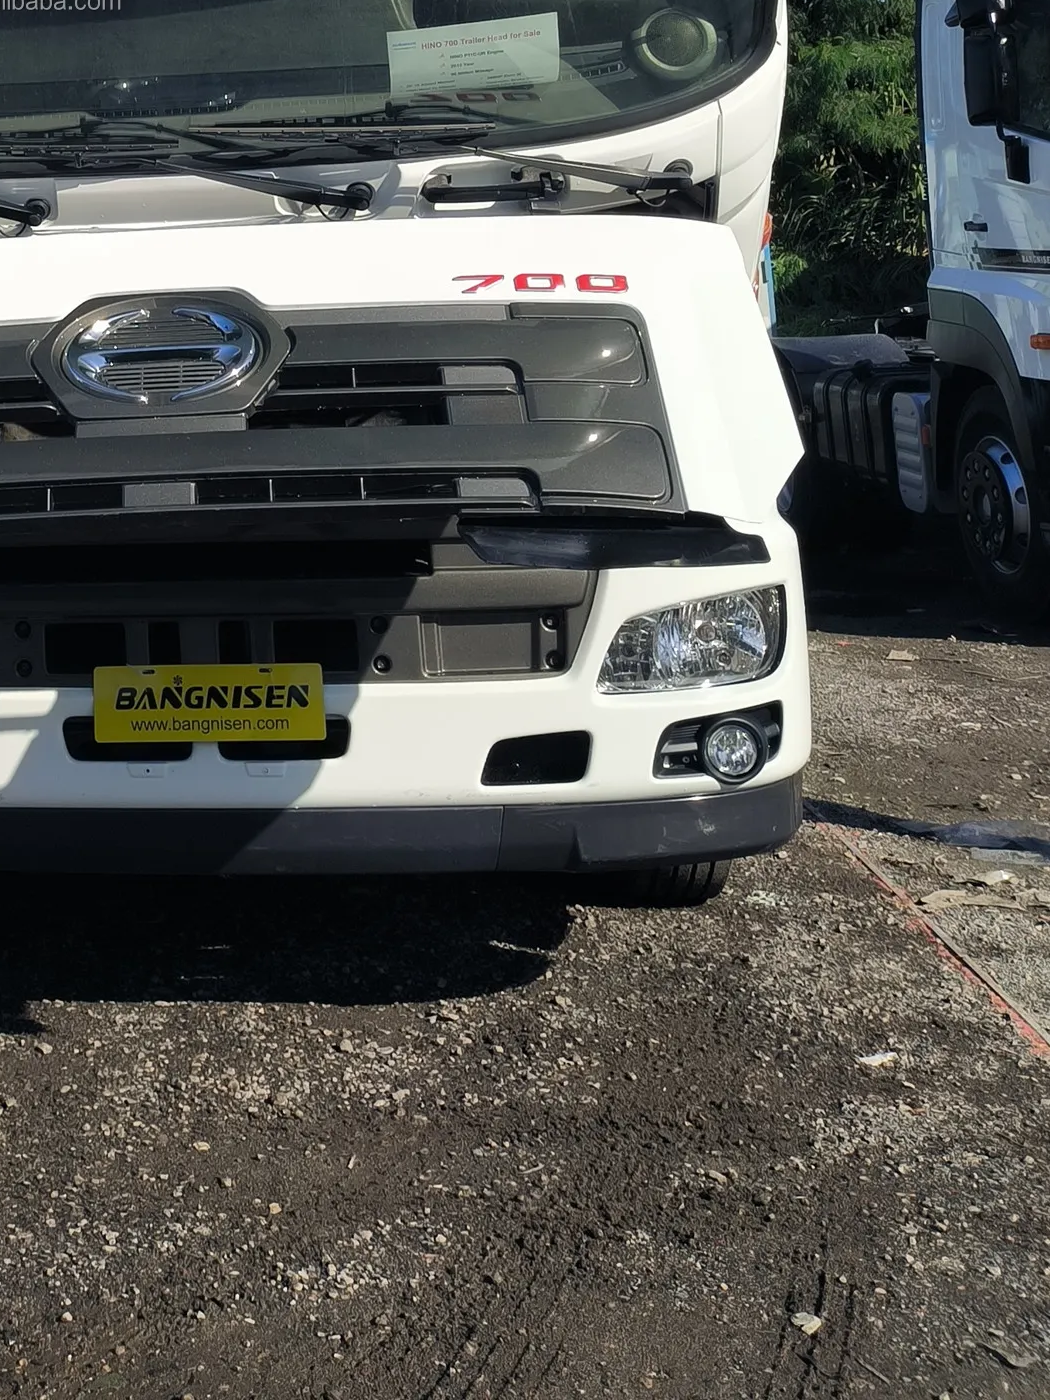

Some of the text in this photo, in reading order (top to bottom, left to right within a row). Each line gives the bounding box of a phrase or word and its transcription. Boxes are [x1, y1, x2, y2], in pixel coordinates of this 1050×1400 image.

[421, 42, 442, 50] HINO
[444, 40, 458, 48] 700
[460, 36, 485, 45] Trailer
[487, 33, 507, 42] Head
[510, 31, 521, 40] for
[523, 29, 541, 38] Sale
[451, 273, 629, 294] 700
[115, 684, 310, 711] BANGNISEN
[131, 716, 290, 734] www.bangnisen.com
